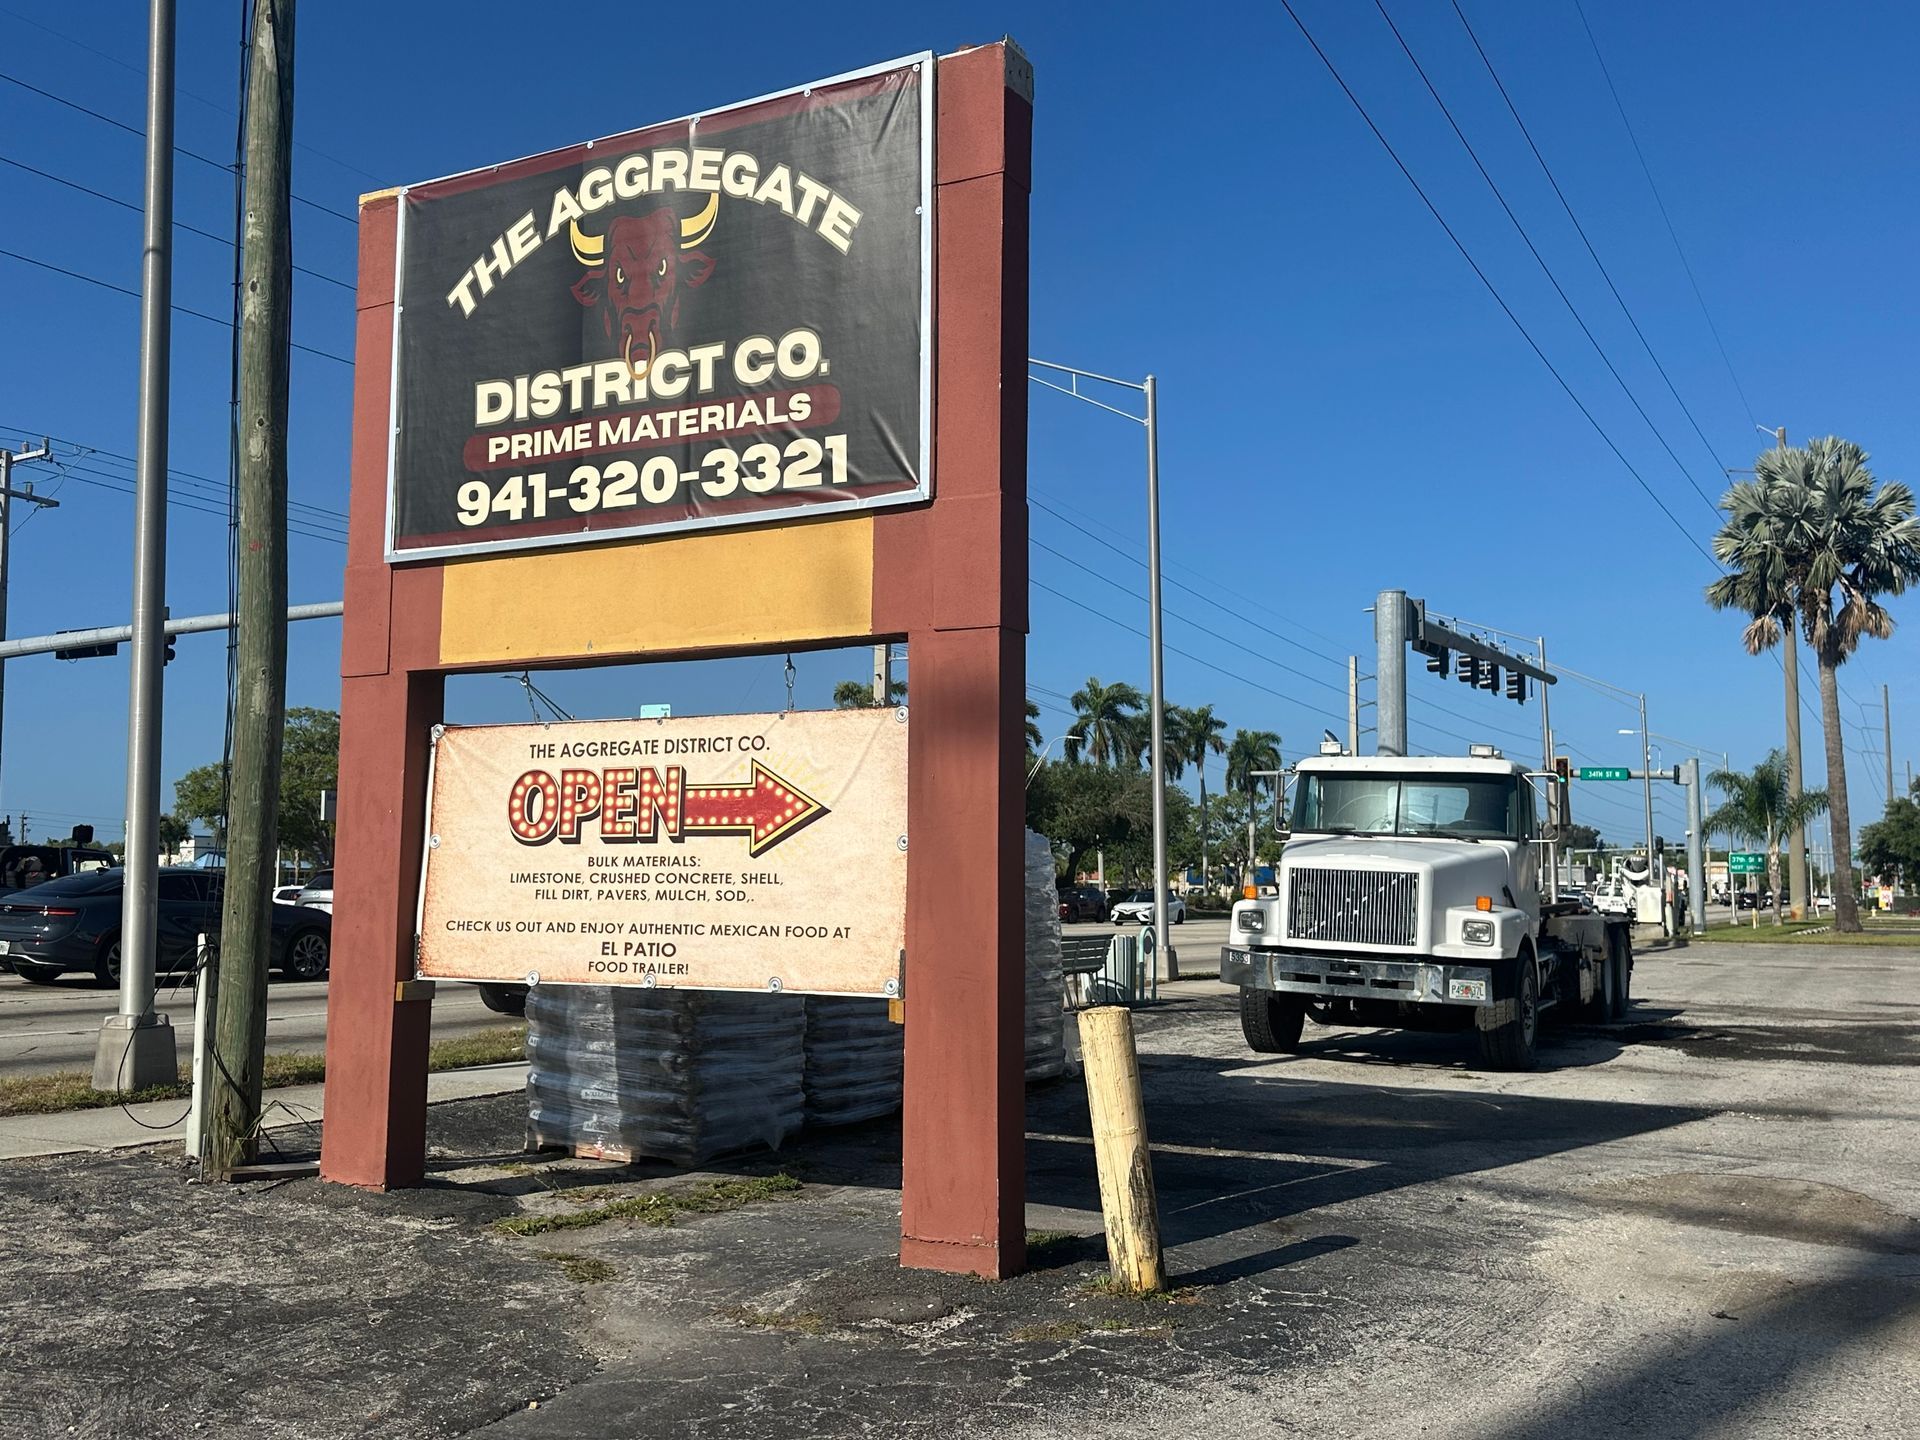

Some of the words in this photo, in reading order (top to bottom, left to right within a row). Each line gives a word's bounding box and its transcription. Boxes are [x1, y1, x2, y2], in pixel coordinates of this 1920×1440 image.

[447, 209, 543, 318] THE
[545, 148, 864, 256] AGGREGATE
[475, 341, 726, 427] DISTRICT
[733, 328, 831, 387] CO.
[487, 423, 593, 463] PRIME
[598, 392, 813, 447] MATERIALS
[456, 434, 849, 527] 941-320-3321
[529, 744, 556, 759] THE
[560, 740, 659, 758] AGGREGATE
[664, 737, 733, 754] DISTRICT
[737, 735, 771, 752] CO.
[508, 764, 686, 847] OPEN
[587, 856, 619, 868] BULK
[622, 856, 702, 868] MATERIALS:
[510, 872, 585, 885] LIMESTONE,
[589, 872, 651, 885] CRUSHED
[654, 873, 736, 886] CONCRETE,
[740, 873, 785, 886] SHELL,
[535, 889, 558, 900] FILL
[562, 889, 593, 902] DIRT,
[597, 889, 651, 902] PAVERS,
[655, 890, 711, 903] MULCH,
[446, 920, 492, 932] CHECK
[496, 921, 512, 932] US
[515, 921, 543, 933] OUT
[545, 922, 576, 933] AND
[580, 922, 625, 934] ENJOY
[628, 923, 706, 936] AUTHENTIC
[709, 924, 780, 937] MEXICAN
[785, 925, 829, 938] FOOD
[832, 927, 851, 939] AT
[601, 941, 618, 956] EL
[624, 942, 677, 958] PATIO
[588, 961, 628, 973] FOOD
[632, 962, 689, 975] TRAILER!
